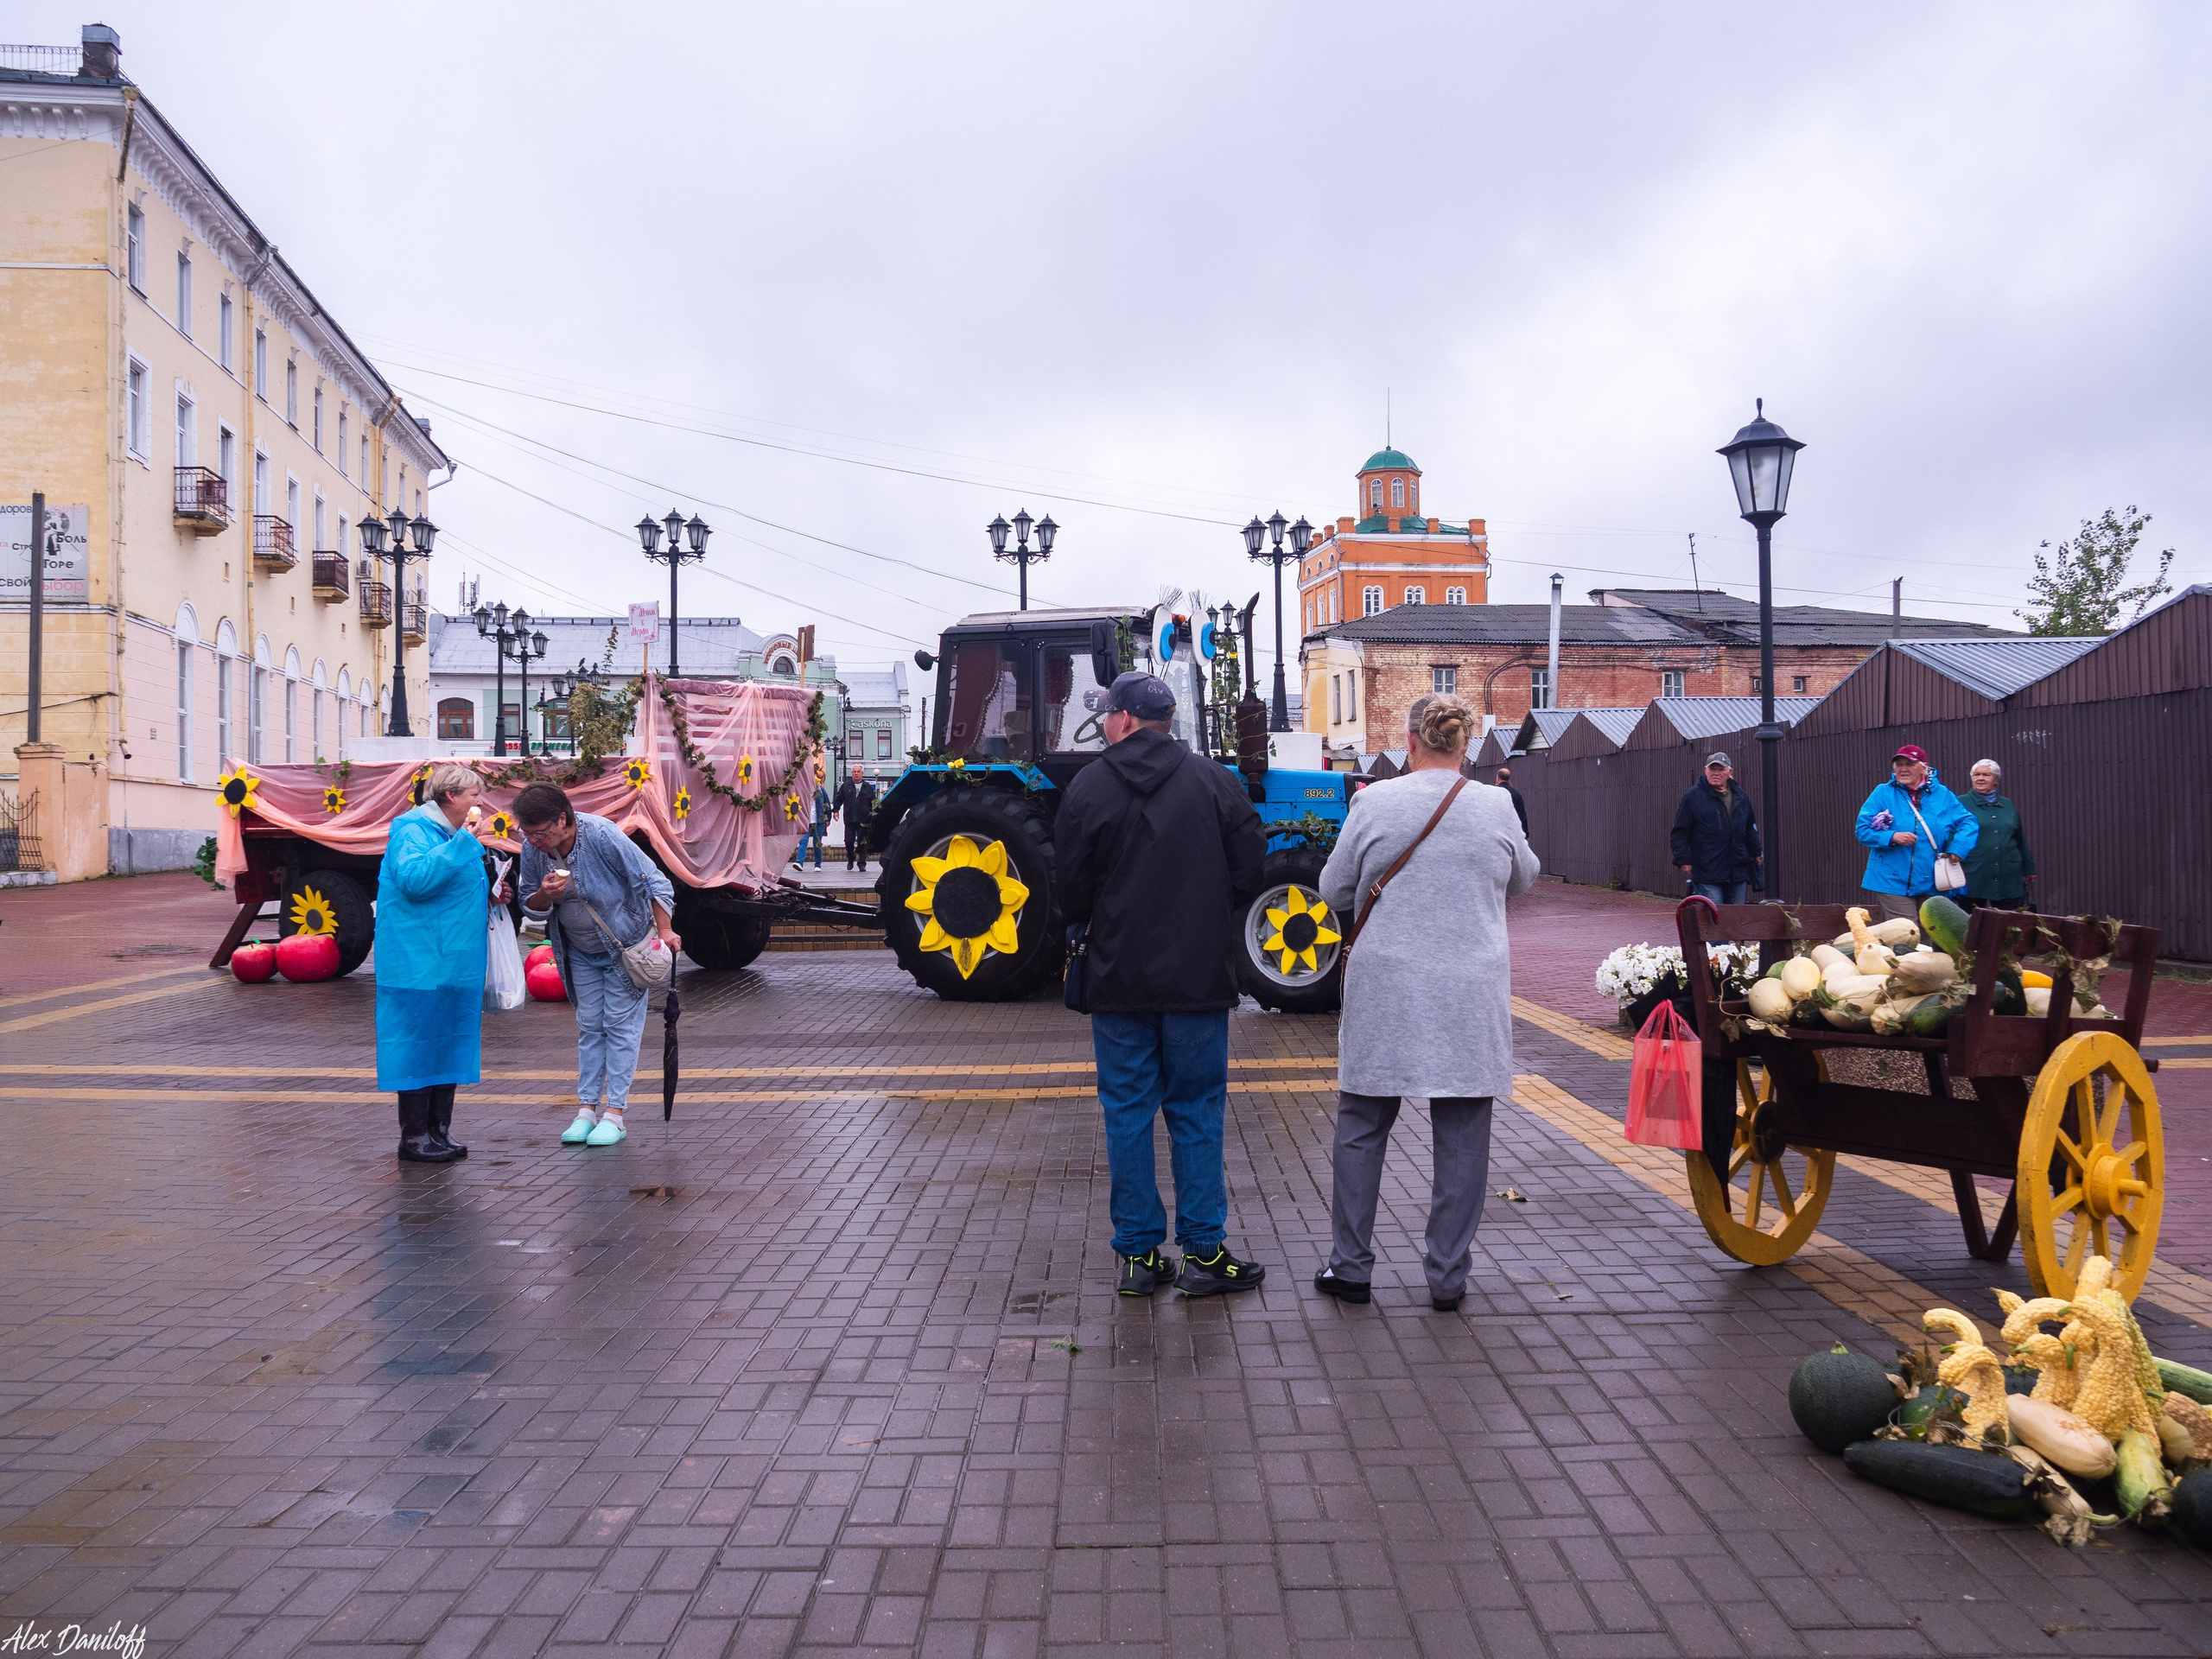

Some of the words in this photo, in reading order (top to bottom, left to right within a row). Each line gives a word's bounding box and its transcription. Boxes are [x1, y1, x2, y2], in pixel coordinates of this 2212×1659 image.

[0, 505, 33, 516] доров
[41, 578, 84, 594] ыбор
[1304, 788, 1334, 798] 892.2
